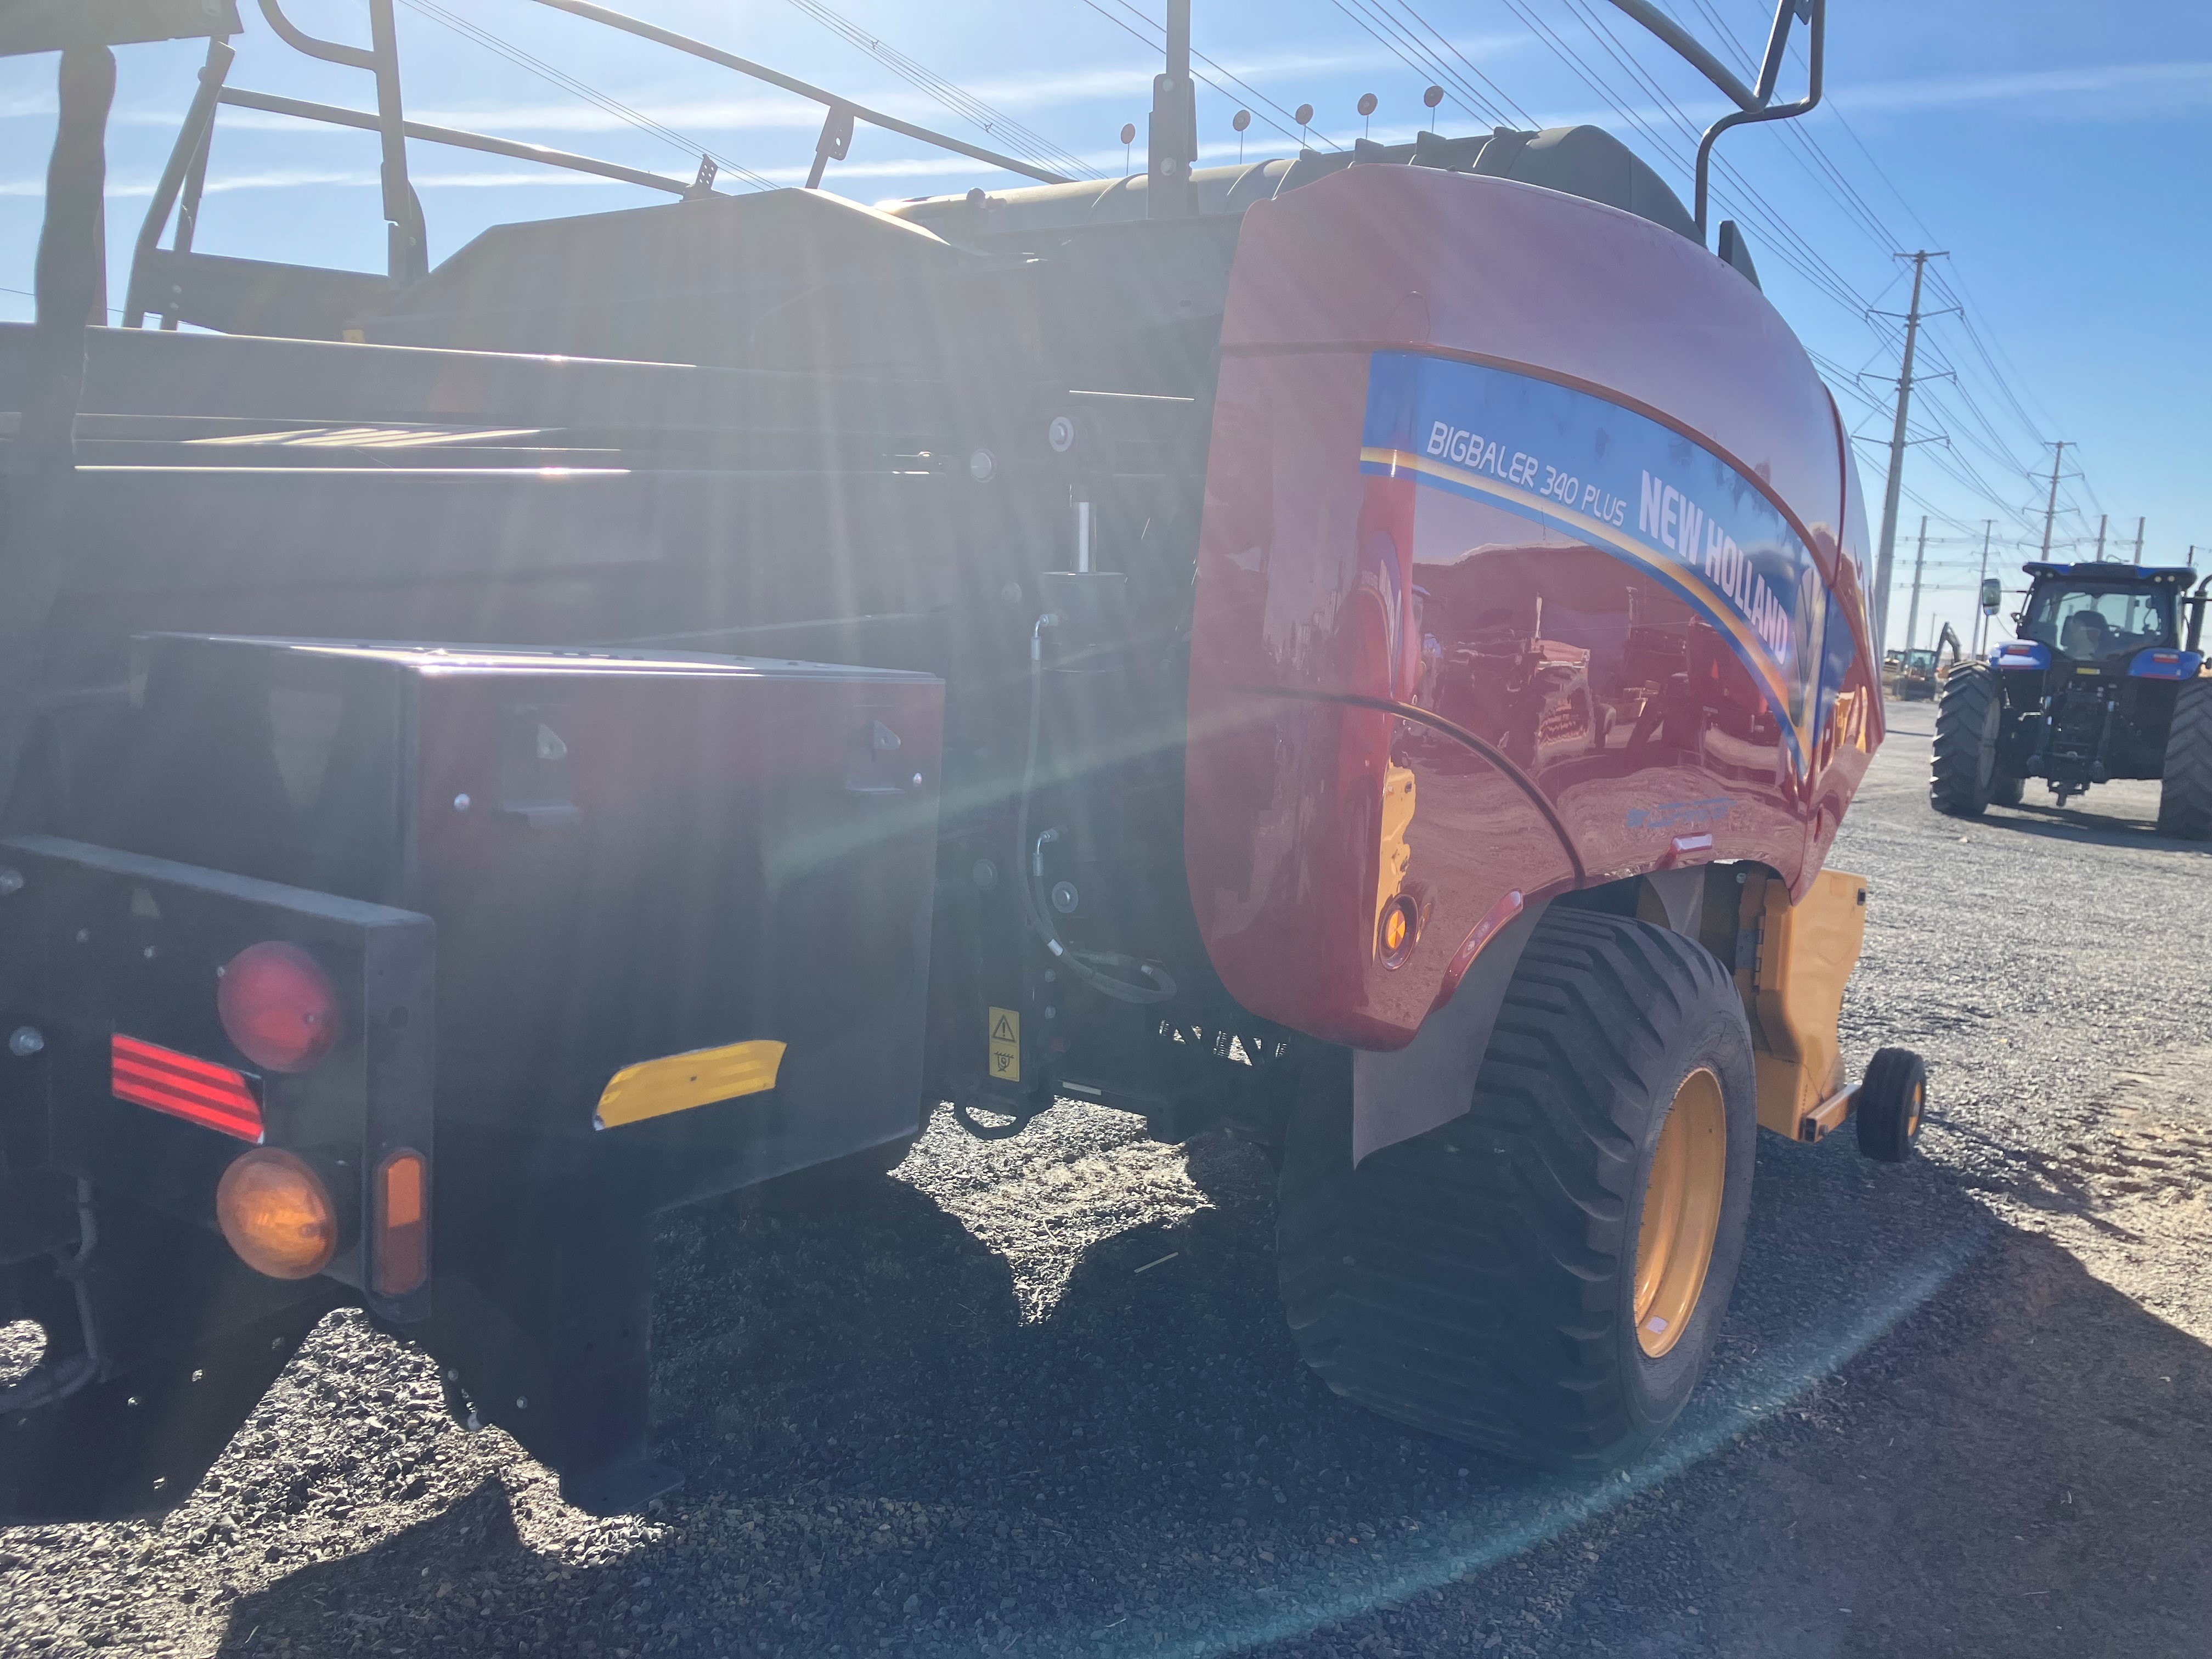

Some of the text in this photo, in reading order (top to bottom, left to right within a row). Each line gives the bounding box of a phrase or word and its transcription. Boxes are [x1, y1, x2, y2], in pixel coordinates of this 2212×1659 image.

[1426, 420, 1627, 527] BIGBALER 340 PLUS
[1639, 469, 1788, 665] NEW HOLLAND
